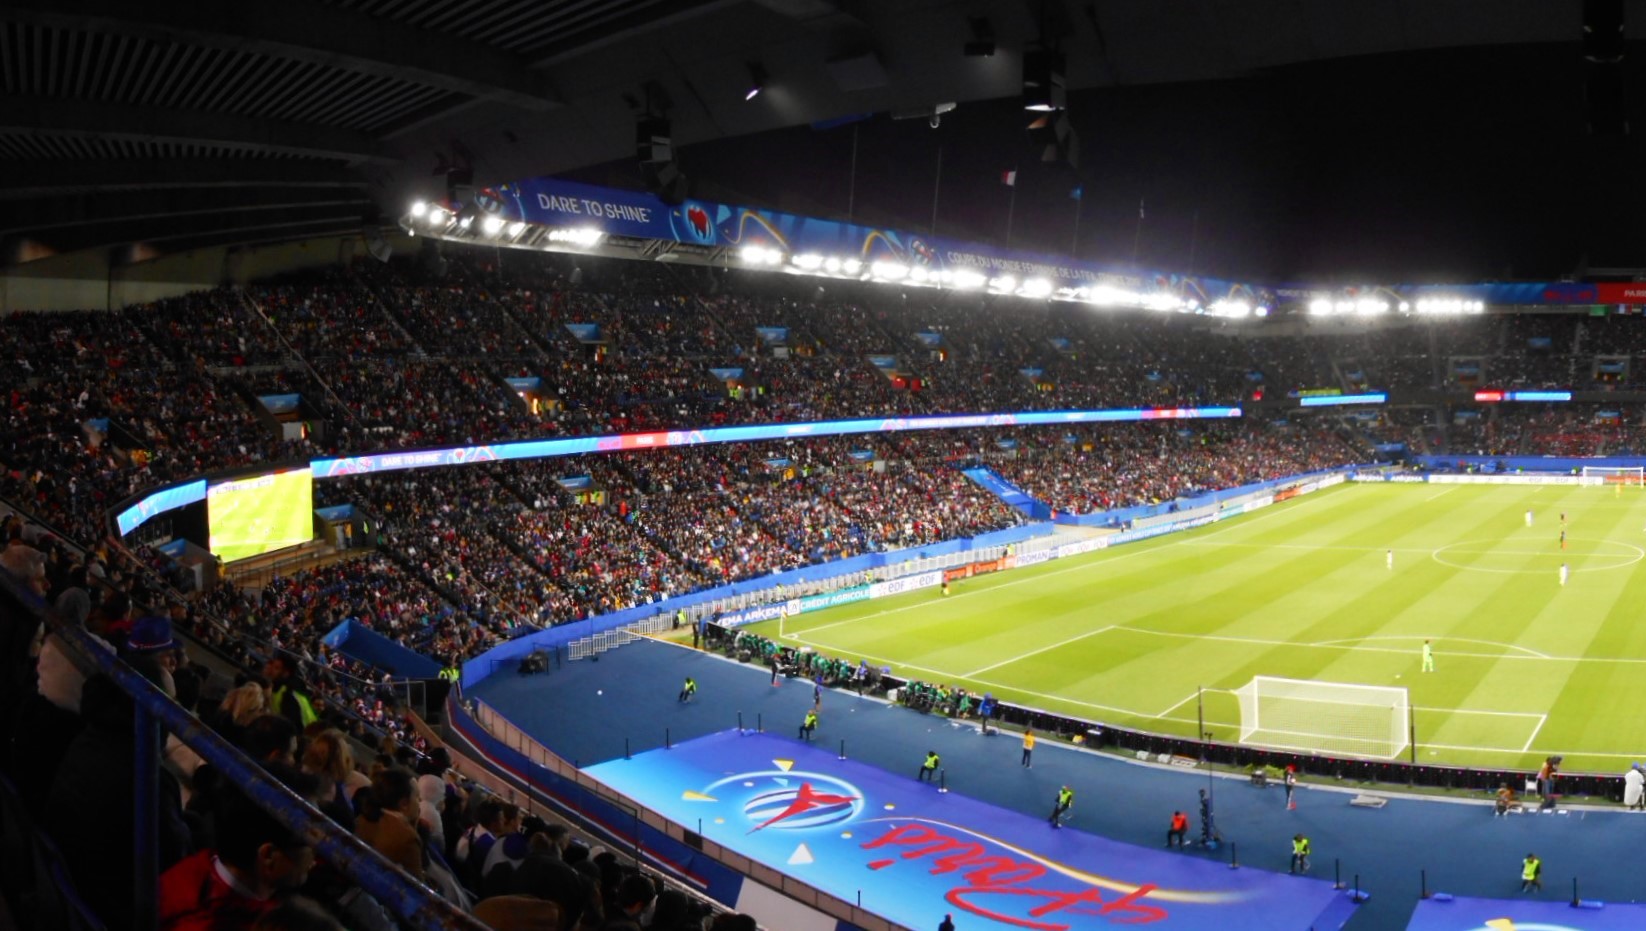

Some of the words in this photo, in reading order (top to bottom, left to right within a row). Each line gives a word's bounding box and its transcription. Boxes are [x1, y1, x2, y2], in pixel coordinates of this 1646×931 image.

[537, 193, 581, 214] DARE
[582, 199, 603, 217] TO
[605, 204, 651, 223] SHINE
[947, 251, 979, 268] COUPE
[979, 256, 991, 269] DU
[1059, 266, 1071, 279] DE
[1016, 549, 1048, 566] PROMAN
[831, 589, 870, 604] AGRICOLE
[716, 613, 743, 627] KEMA
[744, 602, 787, 621] ARKEMA
